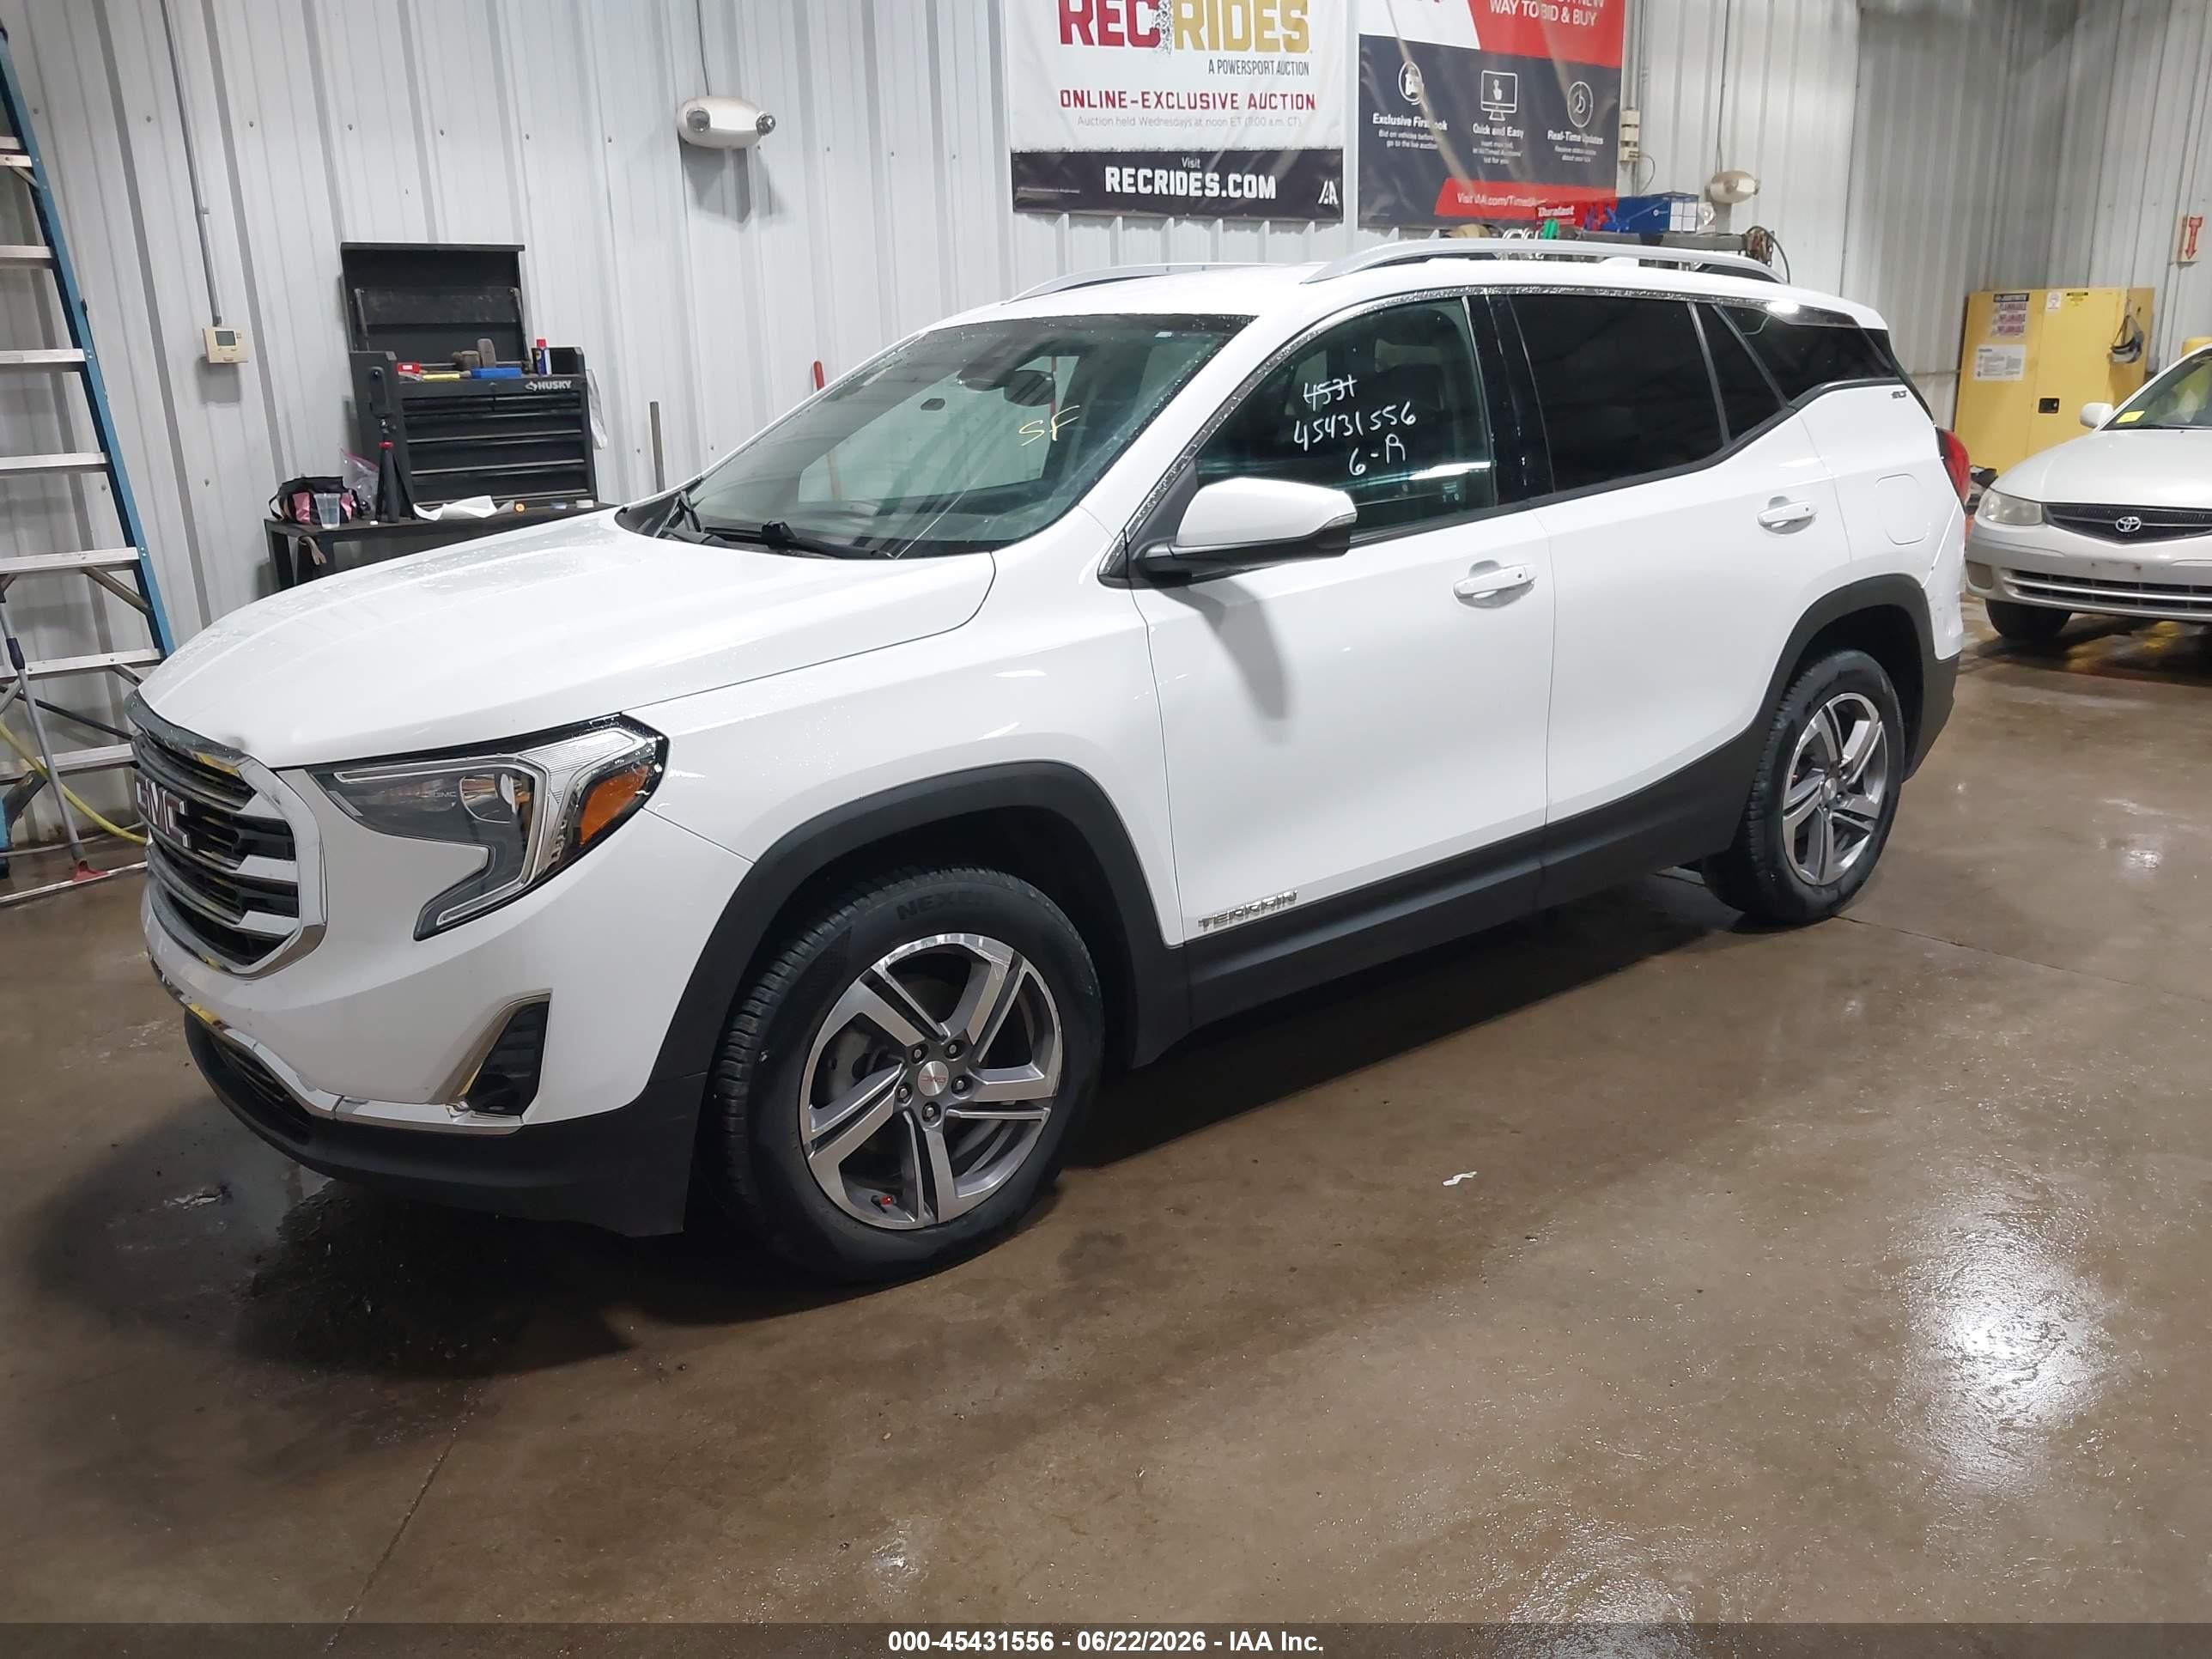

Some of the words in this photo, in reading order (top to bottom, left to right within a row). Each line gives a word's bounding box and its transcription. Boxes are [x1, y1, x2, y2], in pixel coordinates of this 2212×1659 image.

[1490, 0, 1519, 15] WAY
[1521, 1, 1540, 18] TO
[1540, 3, 1559, 21] BID
[1561, 7, 1570, 23] &
[1572, 9, 1597, 27] BUY
[1208, 58, 1215, 75] A
[1217, 59, 1275, 76] POWERSPORT
[1276, 61, 1310, 76] AUCTION
[1060, 89, 1239, 110] ONLINE-EXCLUSIVE
[1248, 92, 1316, 110] AUCTION
[1078, 116, 1114, 126] Auction
[1115, 116, 1136, 126] held
[1372, 112, 1413, 127] Exclusive
[1473, 123, 1491, 135] Quick
[1507, 126, 1524, 139] Easy
[1182, 156, 1200, 169] Visit
[1104, 166, 1276, 199] RECRIDES.COM
[538, 380, 572, 390] HUSKY
